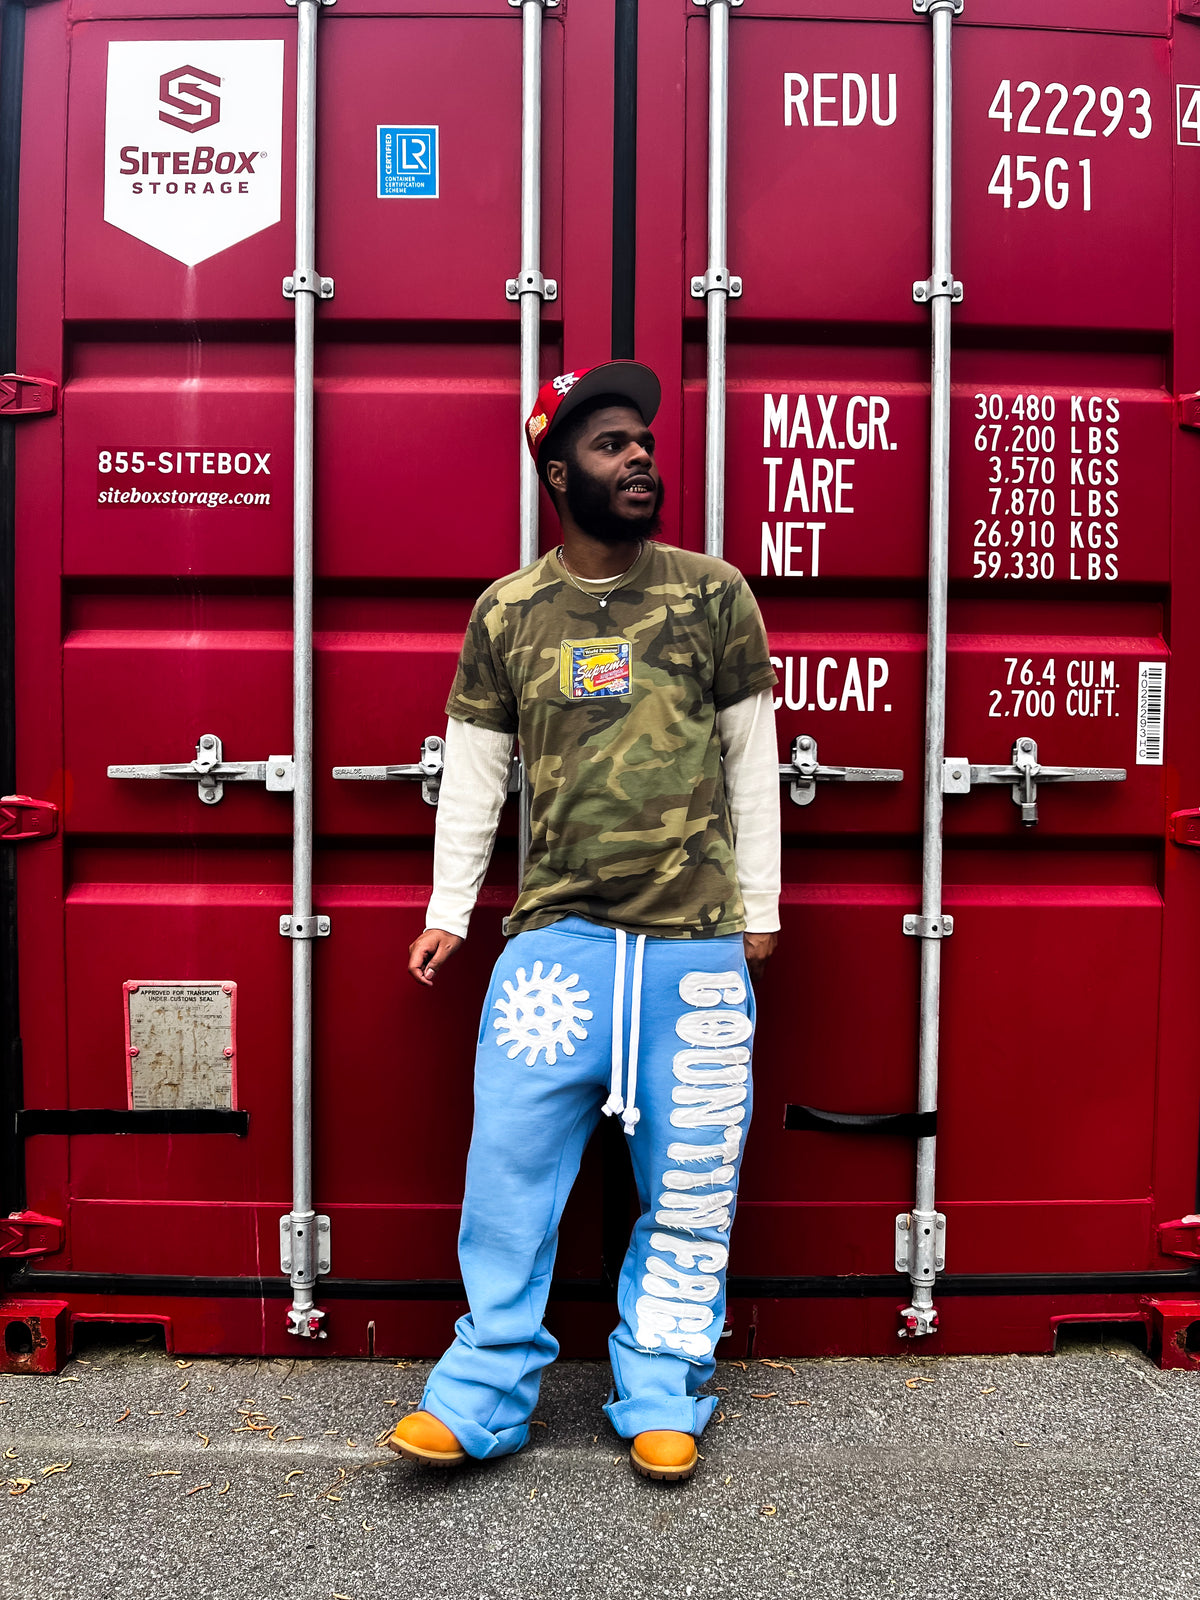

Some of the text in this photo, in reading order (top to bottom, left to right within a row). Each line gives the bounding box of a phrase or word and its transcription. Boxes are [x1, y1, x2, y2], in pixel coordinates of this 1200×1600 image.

[783, 72, 897, 127] REDU
[987, 79, 1200, 142] 422293 4
[131, 181, 249, 194] STORAGE
[987, 155, 1092, 211] 45G1
[763, 394, 898, 451] MAX.GR.
[974, 393, 1120, 423] 30,480 KGS
[974, 424, 1120, 454] 67,200 LBS
[98, 450, 271, 475] 855-SITEBOX
[988, 456, 1120, 486] 3,570 KGS
[97, 487, 271, 508] siteboxstorage.com
[763, 457, 855, 514] TARE
[988, 487, 1119, 518] 7,870 LBS
[760, 521, 826, 577] NET
[973, 519, 1119, 550] 26,910 KGS
[972, 551, 1119, 581] 59,330 LBS
[574, 658, 626, 681] Supreme
[1004, 657, 1120, 688] 76.4 CU.M.
[988, 688, 1120, 718] 2,700 CU.FT.
[654, 970, 753, 1236] COUNTIN
